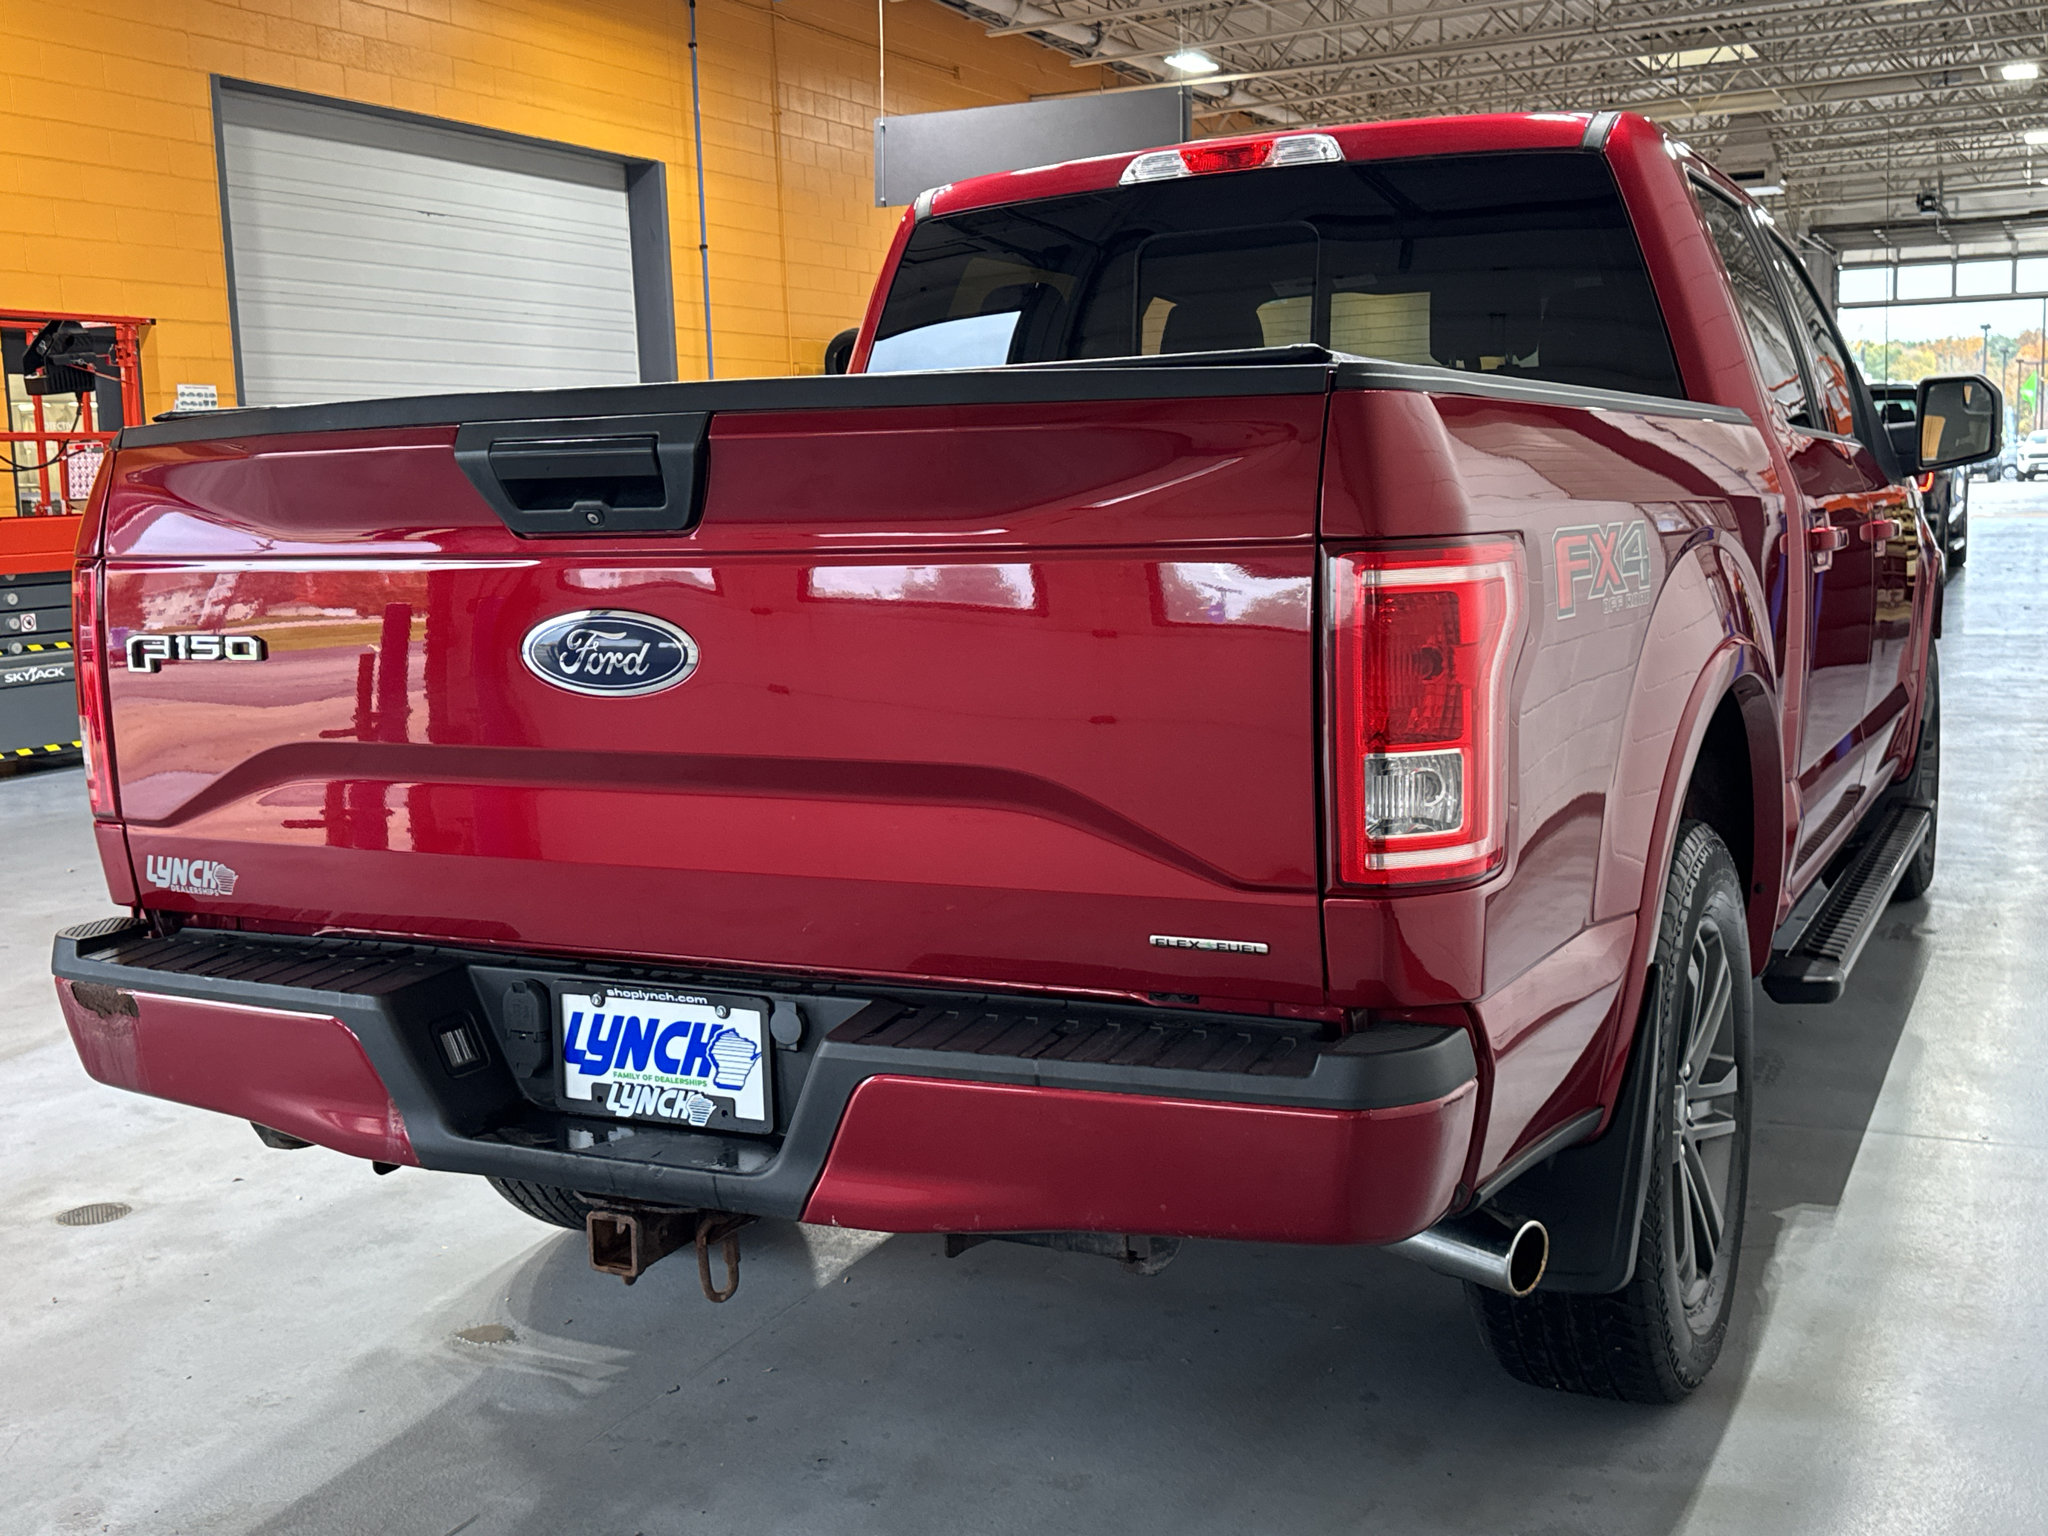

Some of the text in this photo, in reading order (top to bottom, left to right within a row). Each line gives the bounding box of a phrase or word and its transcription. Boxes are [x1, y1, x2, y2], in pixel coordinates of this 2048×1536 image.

[1552, 519, 1651, 620] FX4
[126, 634, 266, 673] F150
[559, 628, 651, 676] Ford
[4, 666, 65, 683] SKYJACK
[146, 854, 218, 888] LYNCH
[170, 883, 220, 897] DEALERSHIPS
[1155, 937, 1266, 954] FLEX FUEL
[606, 987, 708, 1004] shoplynch.com
[564, 1011, 724, 1077] LYNCH
[612, 1071, 708, 1087] FAMILY OF DEALERSHIPS
[605, 1081, 692, 1118] LYNCH
